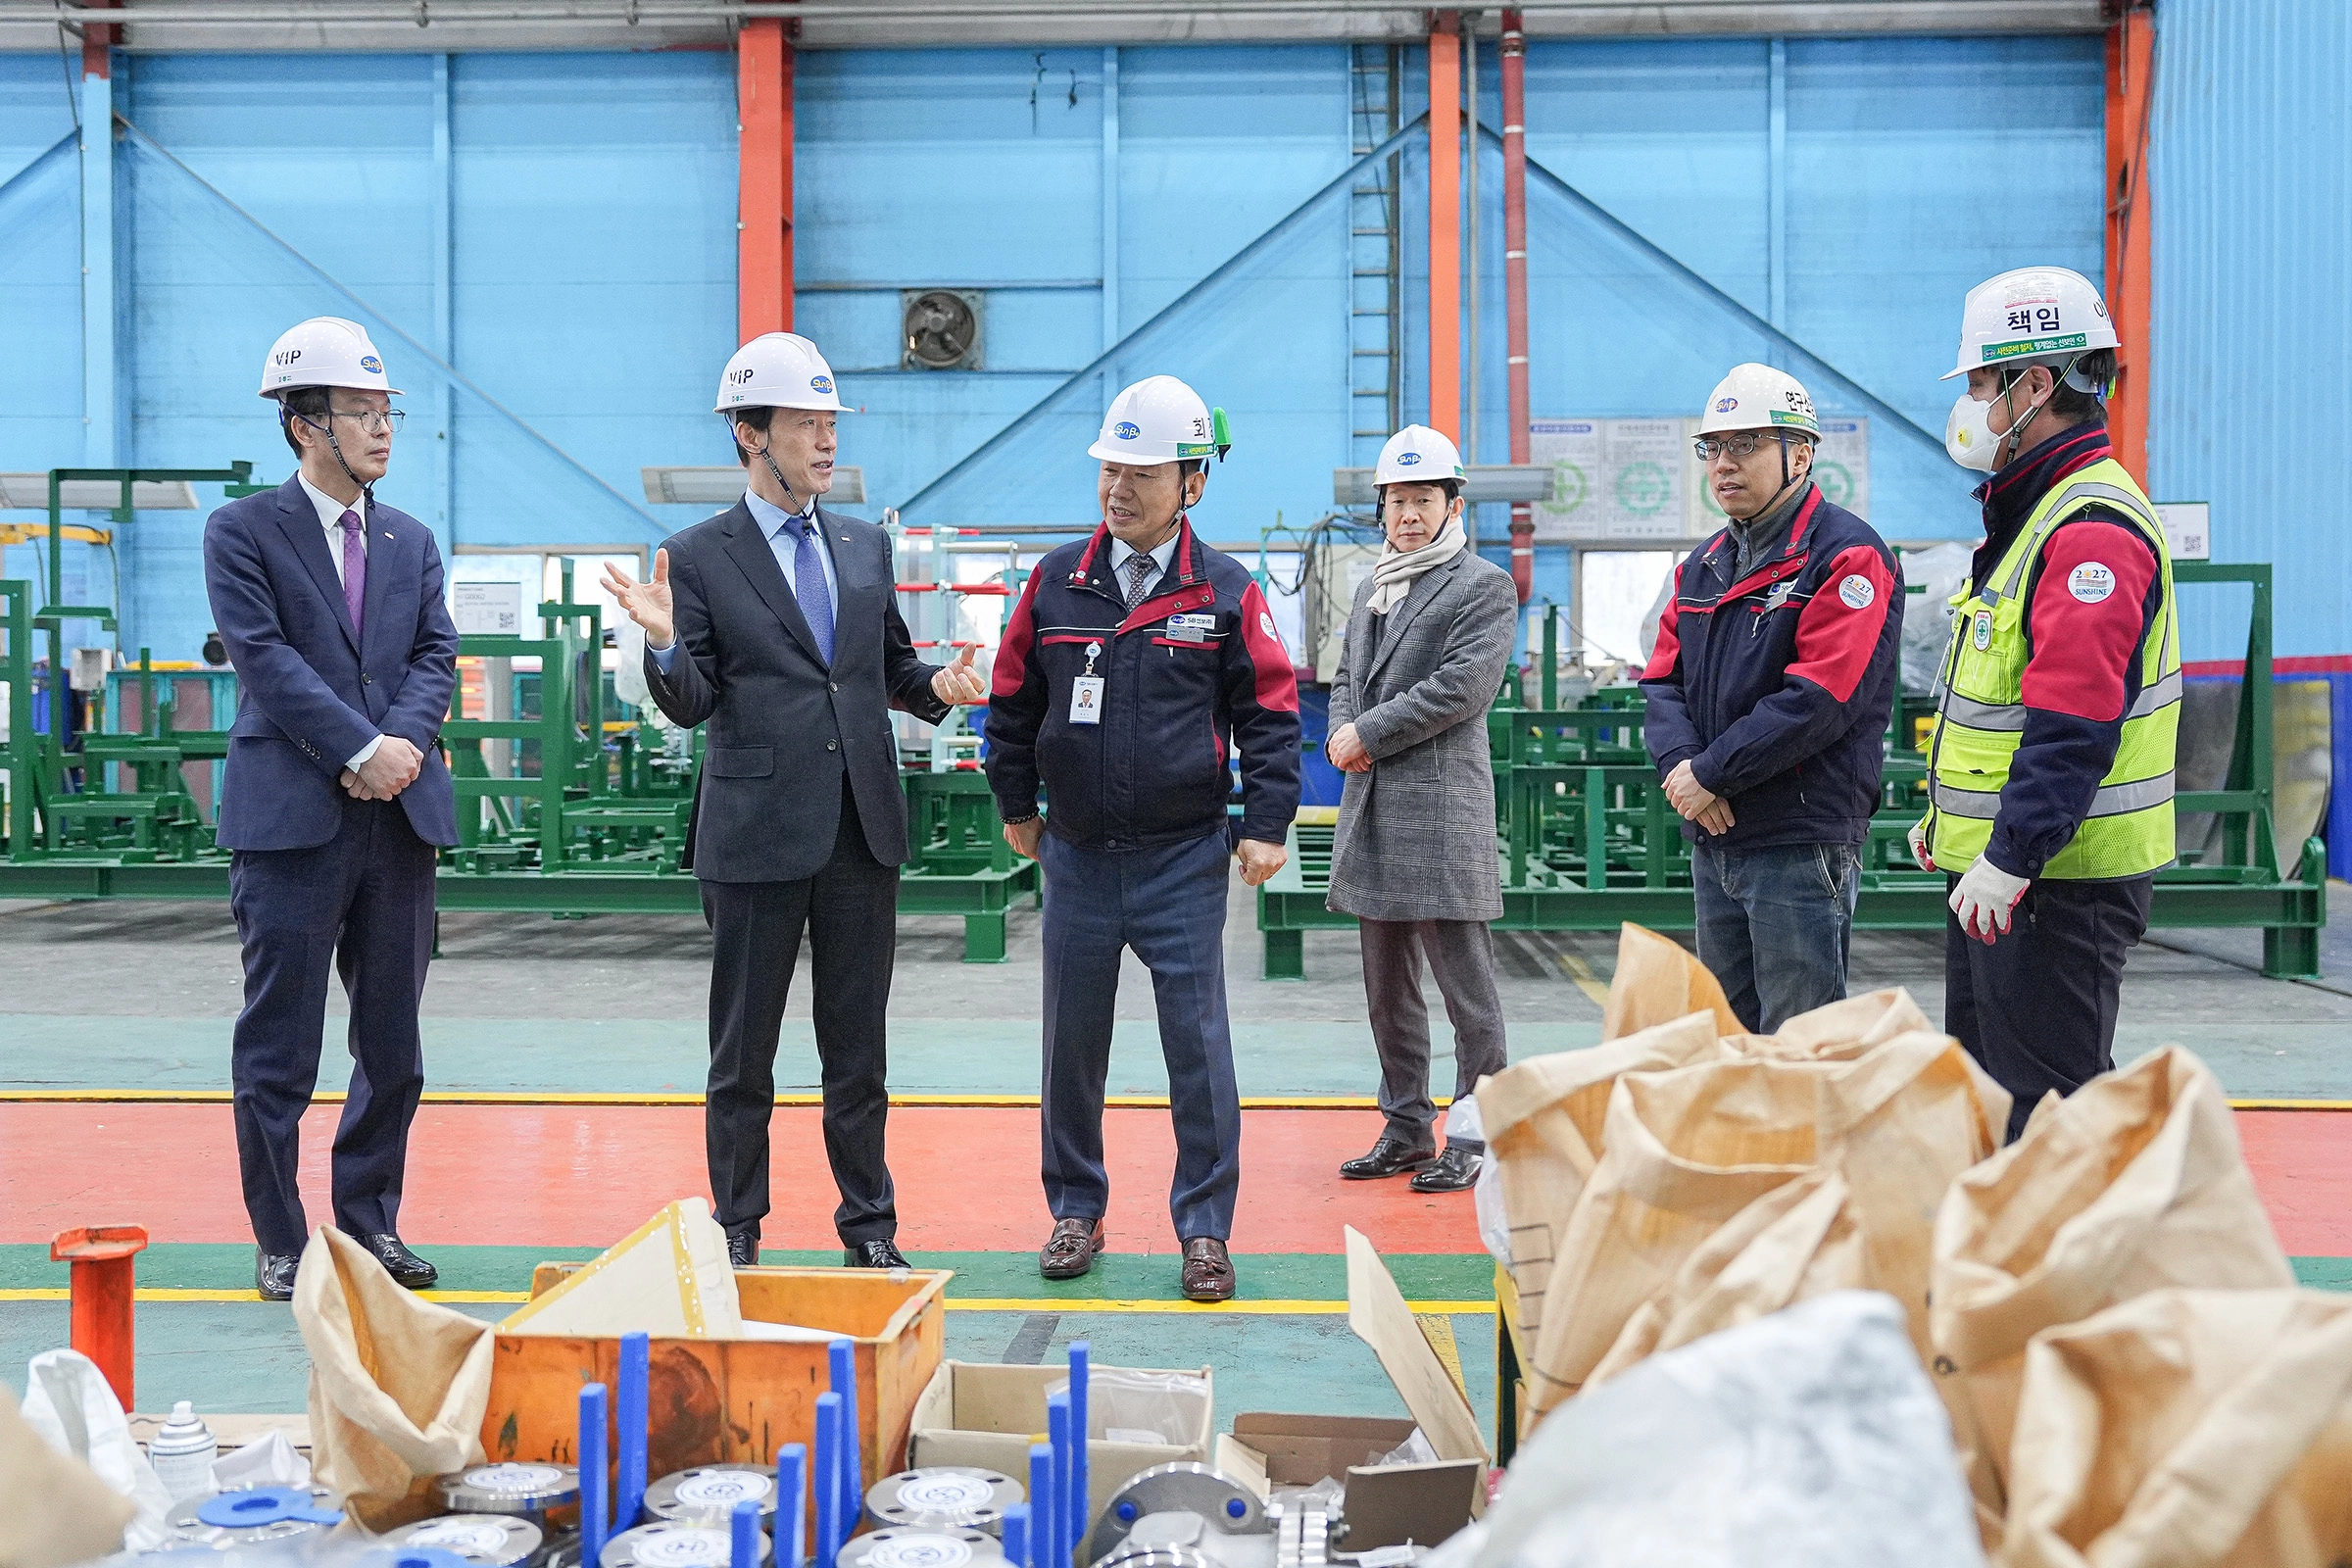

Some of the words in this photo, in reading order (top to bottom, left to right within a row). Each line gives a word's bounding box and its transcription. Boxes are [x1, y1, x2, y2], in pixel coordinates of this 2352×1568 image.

[2007, 307, 2060, 333] 책임
[275, 350, 301, 366] VIP
[729, 368, 754, 386] VIP
